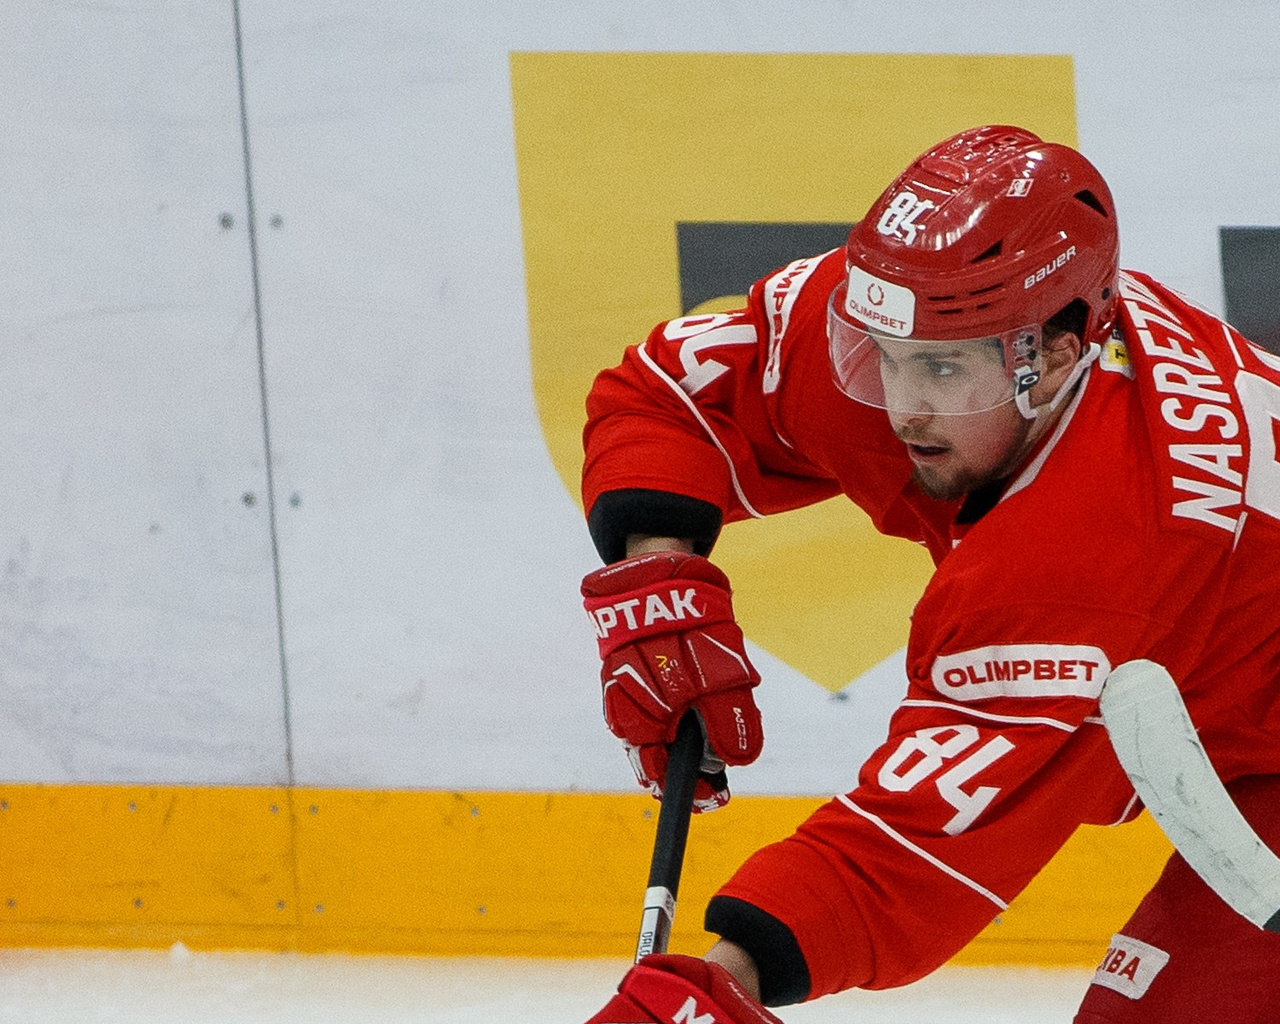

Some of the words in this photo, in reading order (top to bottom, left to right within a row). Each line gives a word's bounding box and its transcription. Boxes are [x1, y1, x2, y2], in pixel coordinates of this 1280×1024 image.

[876, 191, 935, 246] 84
[849, 299, 908, 331] OLIMPBET
[943, 659, 1099, 688] OLIMPBET
[877, 724, 1017, 837] 84
[1096, 947, 1142, 982] ВА
